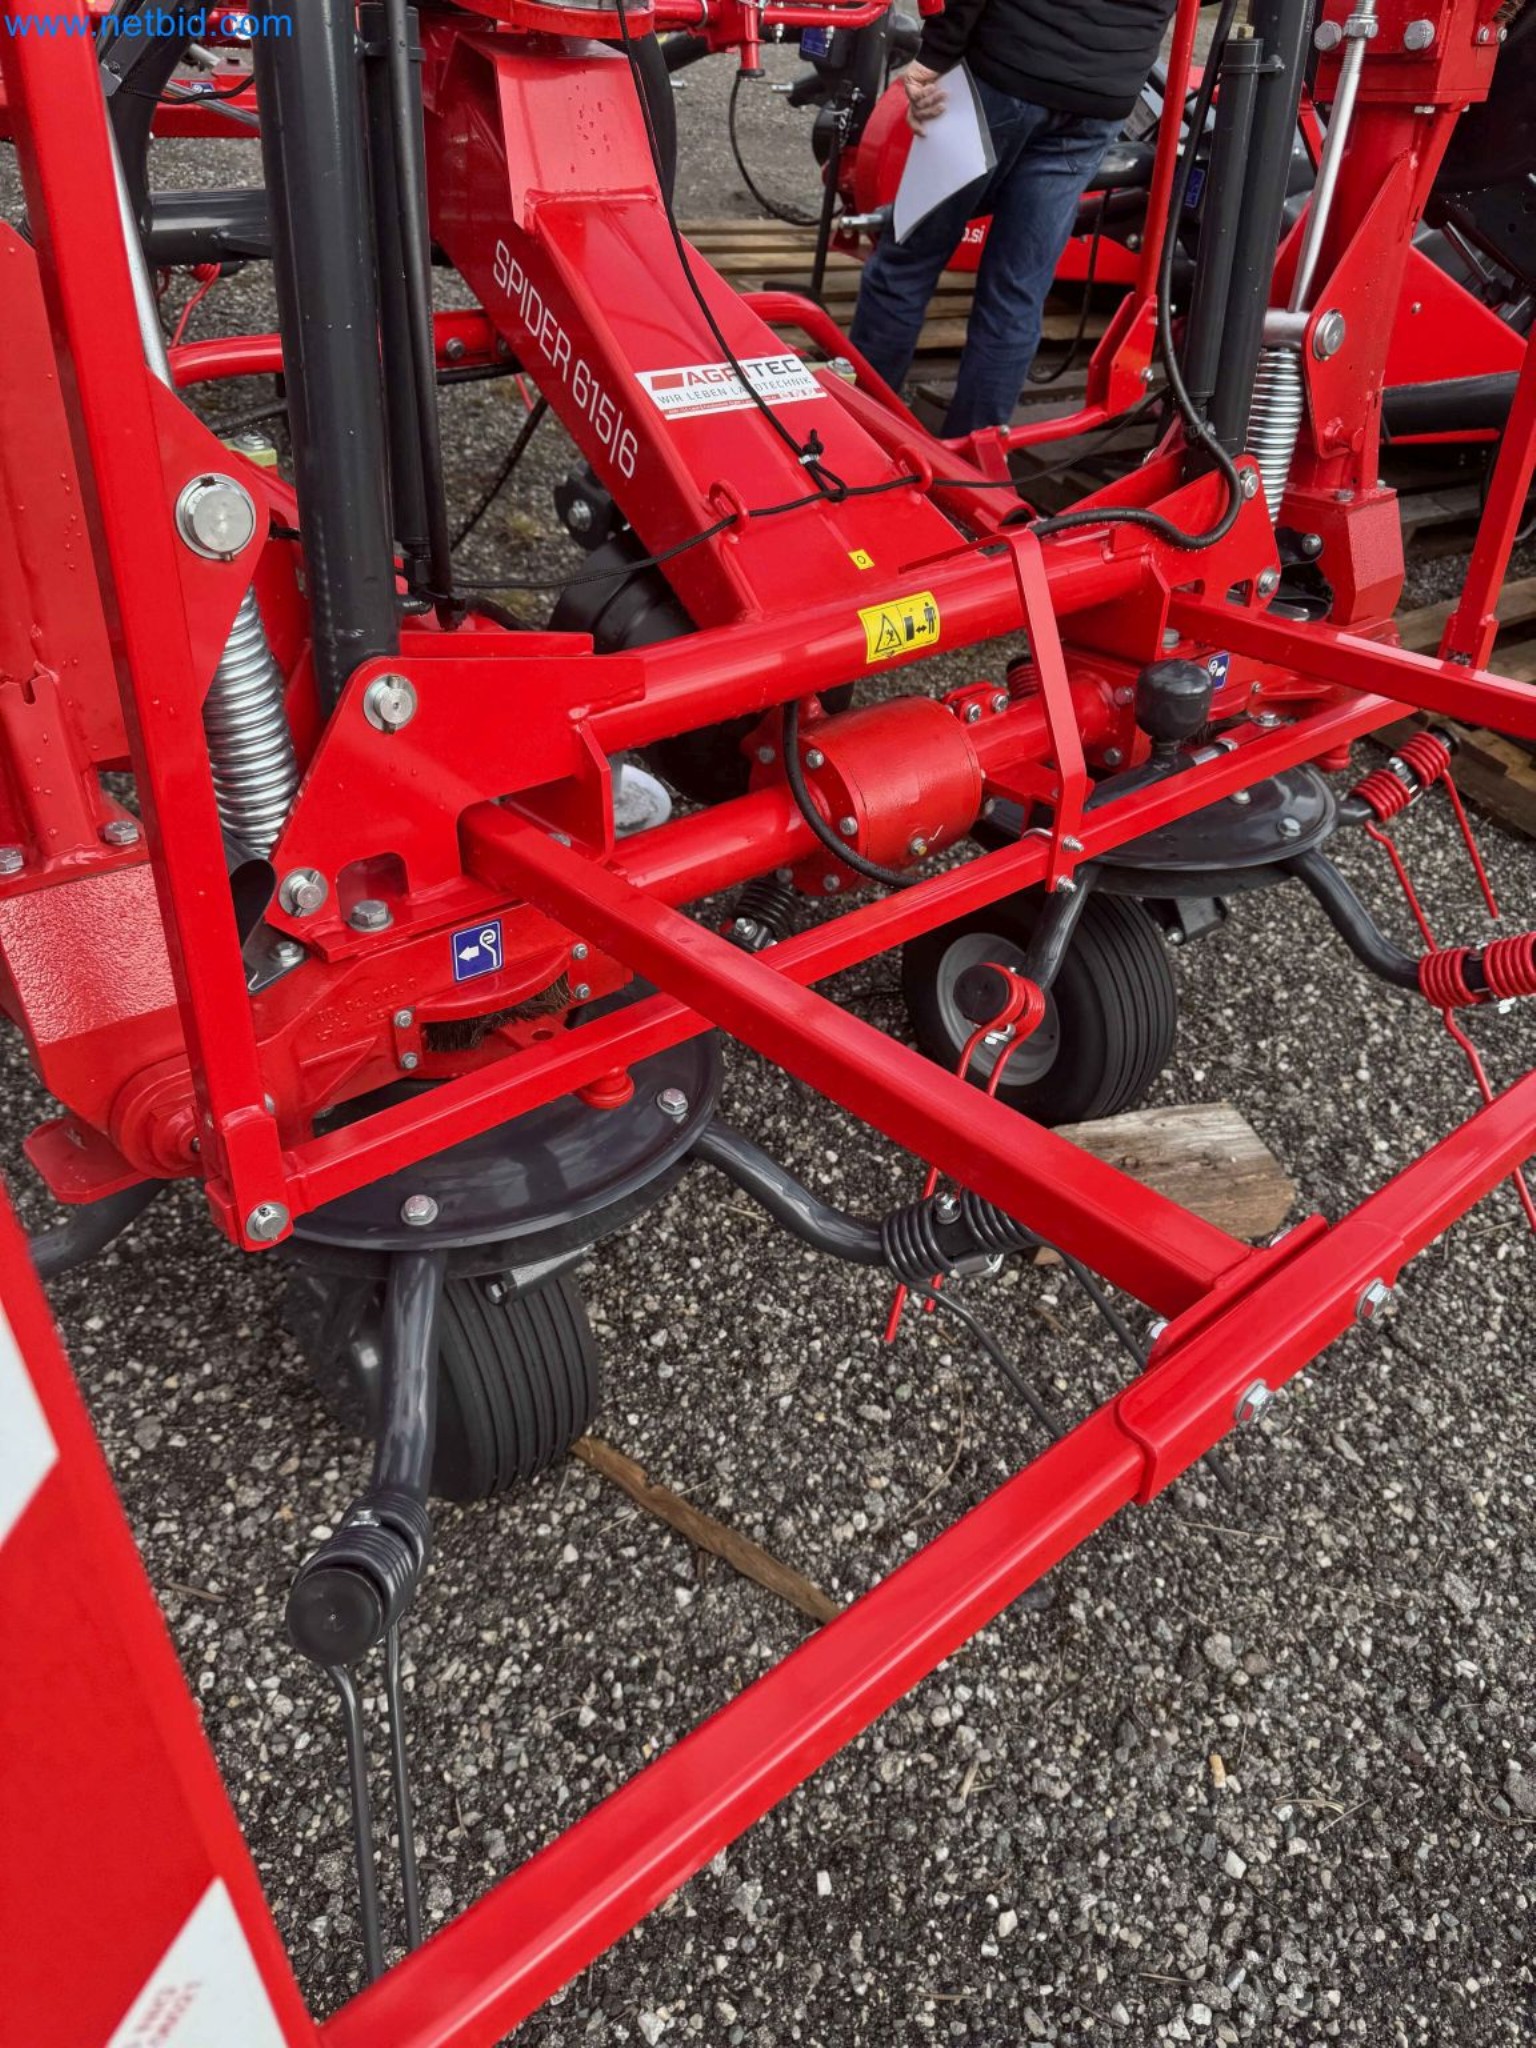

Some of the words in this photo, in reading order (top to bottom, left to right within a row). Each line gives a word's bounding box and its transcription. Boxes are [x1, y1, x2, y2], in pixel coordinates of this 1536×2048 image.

[493, 239, 571, 383] SPIDER
[657, 393, 683, 405] WIR
[686, 387, 728, 401] LEBEN
[730, 377, 812, 396] LADTECHNIK
